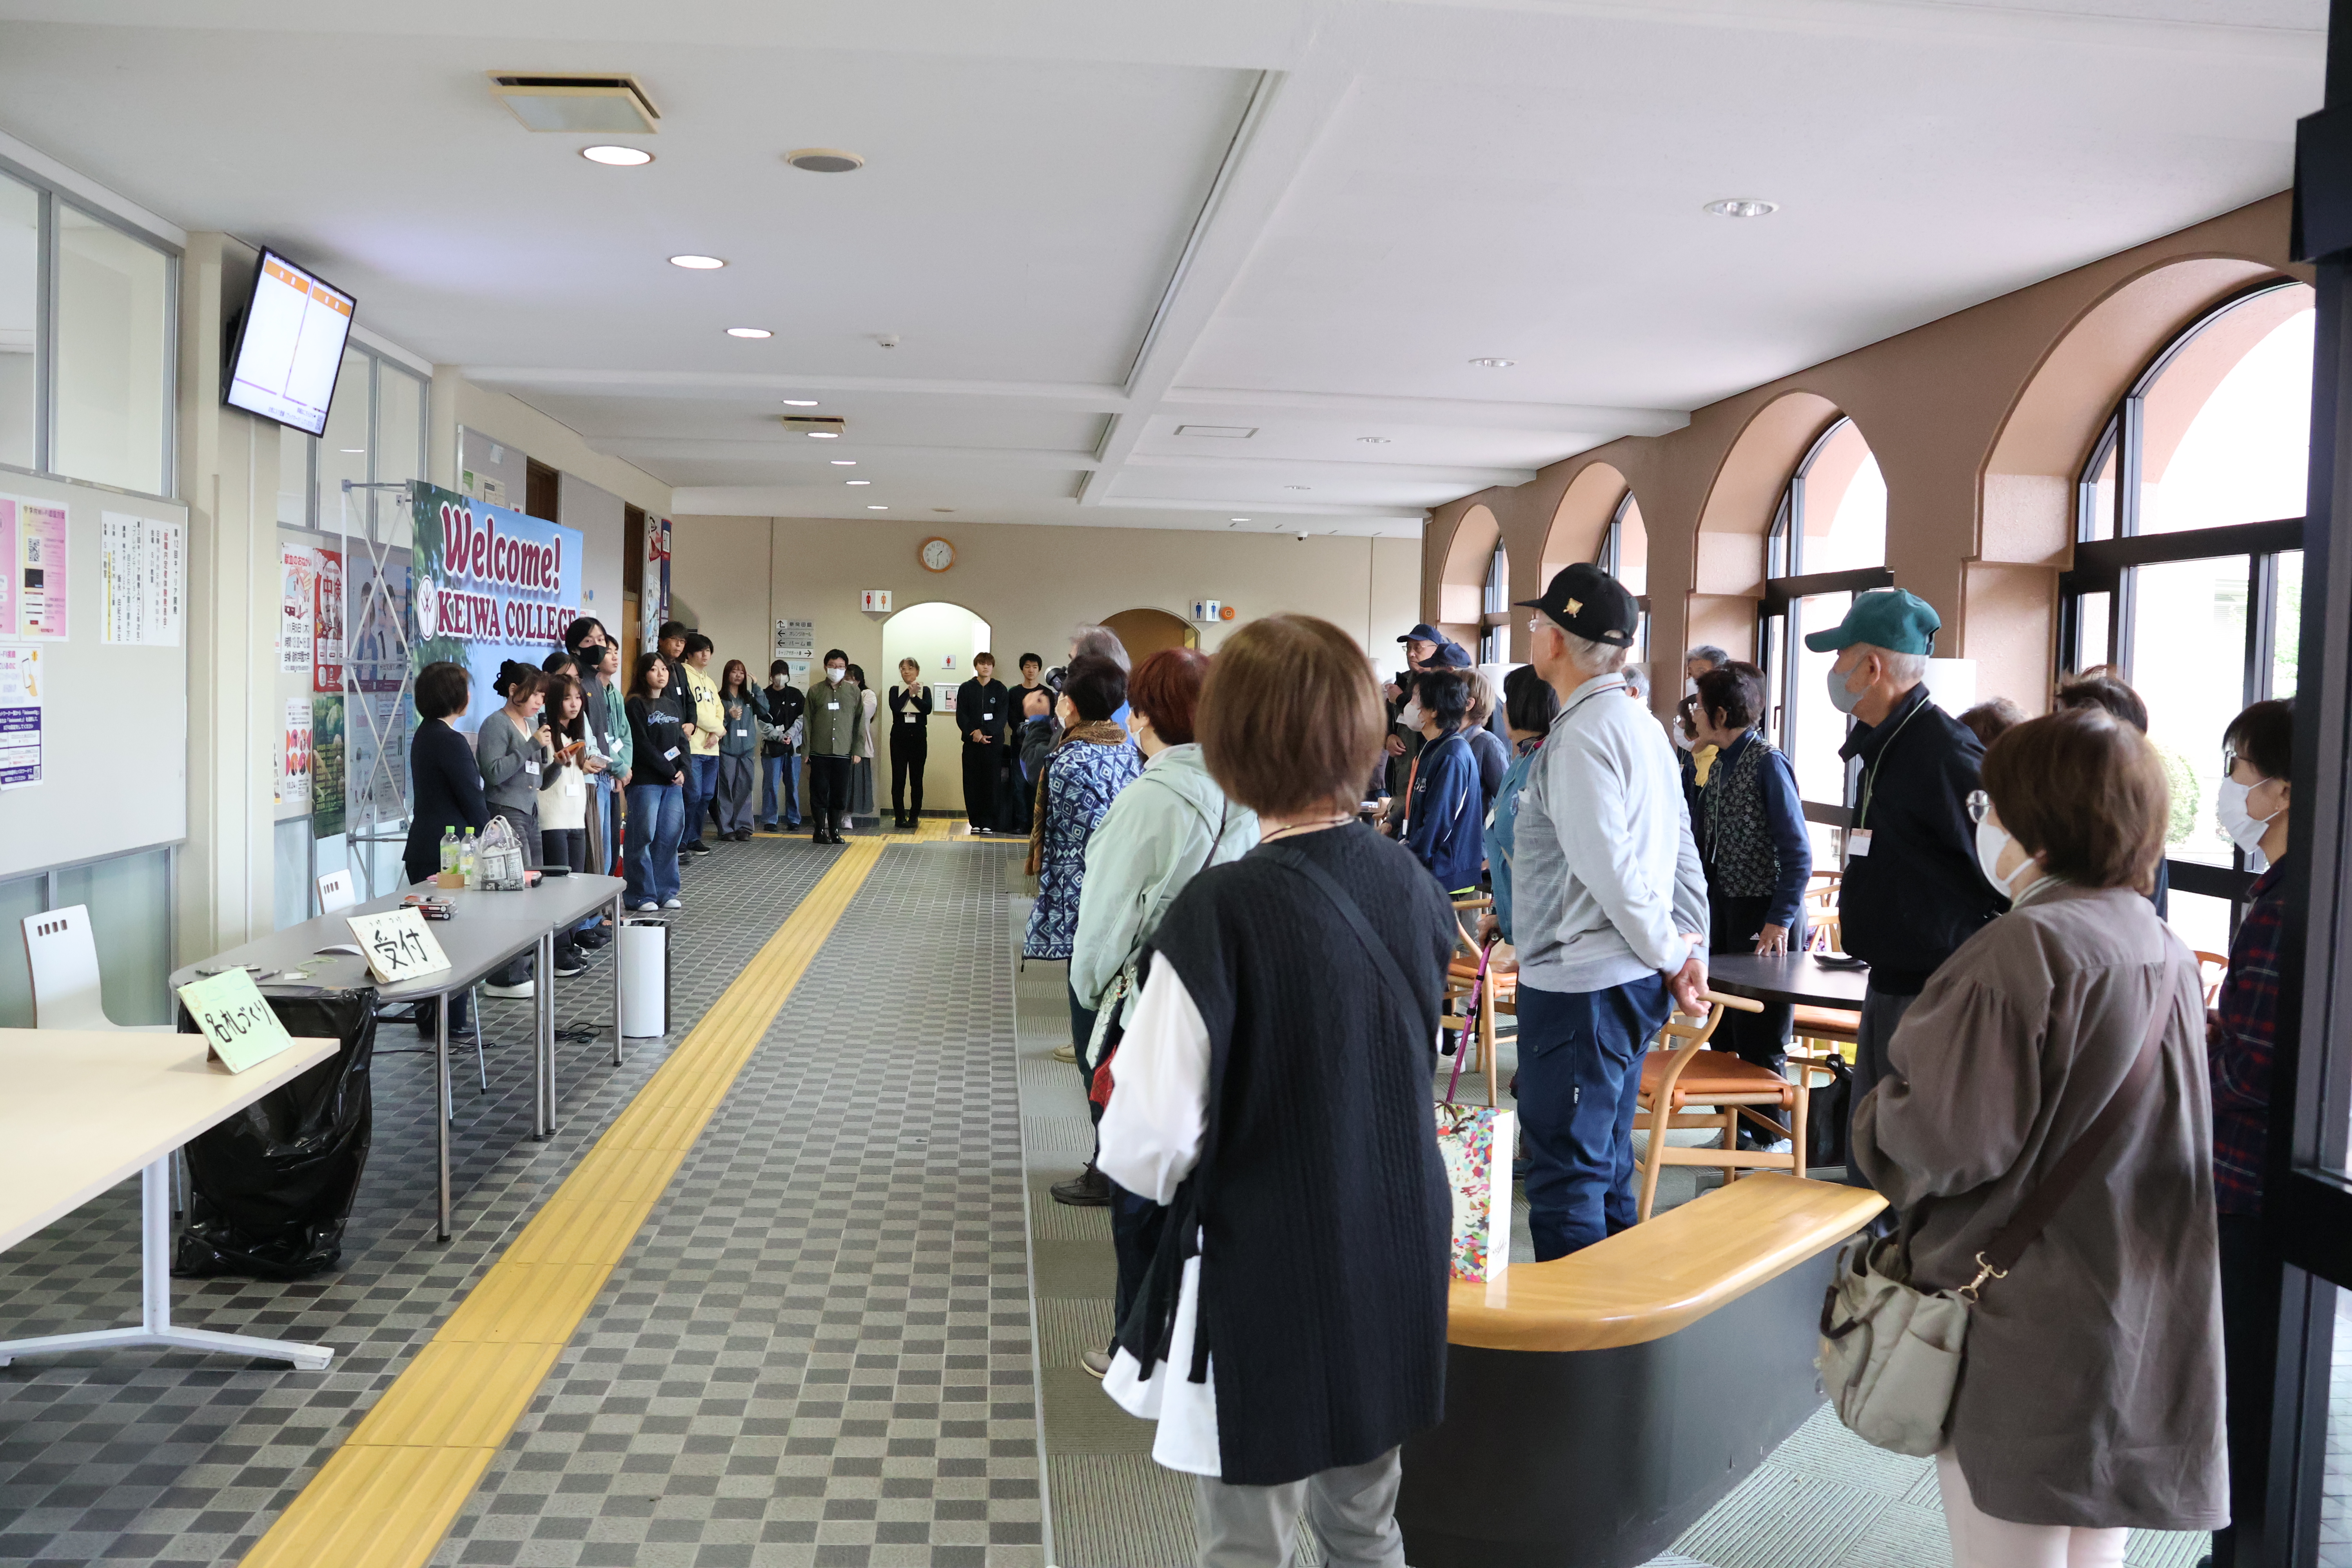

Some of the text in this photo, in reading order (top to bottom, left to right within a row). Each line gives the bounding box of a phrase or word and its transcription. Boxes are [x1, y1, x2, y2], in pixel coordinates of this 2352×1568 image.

[441, 503, 561, 592] Welcome!
[437, 590, 501, 638] KEIWA
[374, 928, 428, 970] 受付
[205, 999, 272, 1043] 名札づくり
